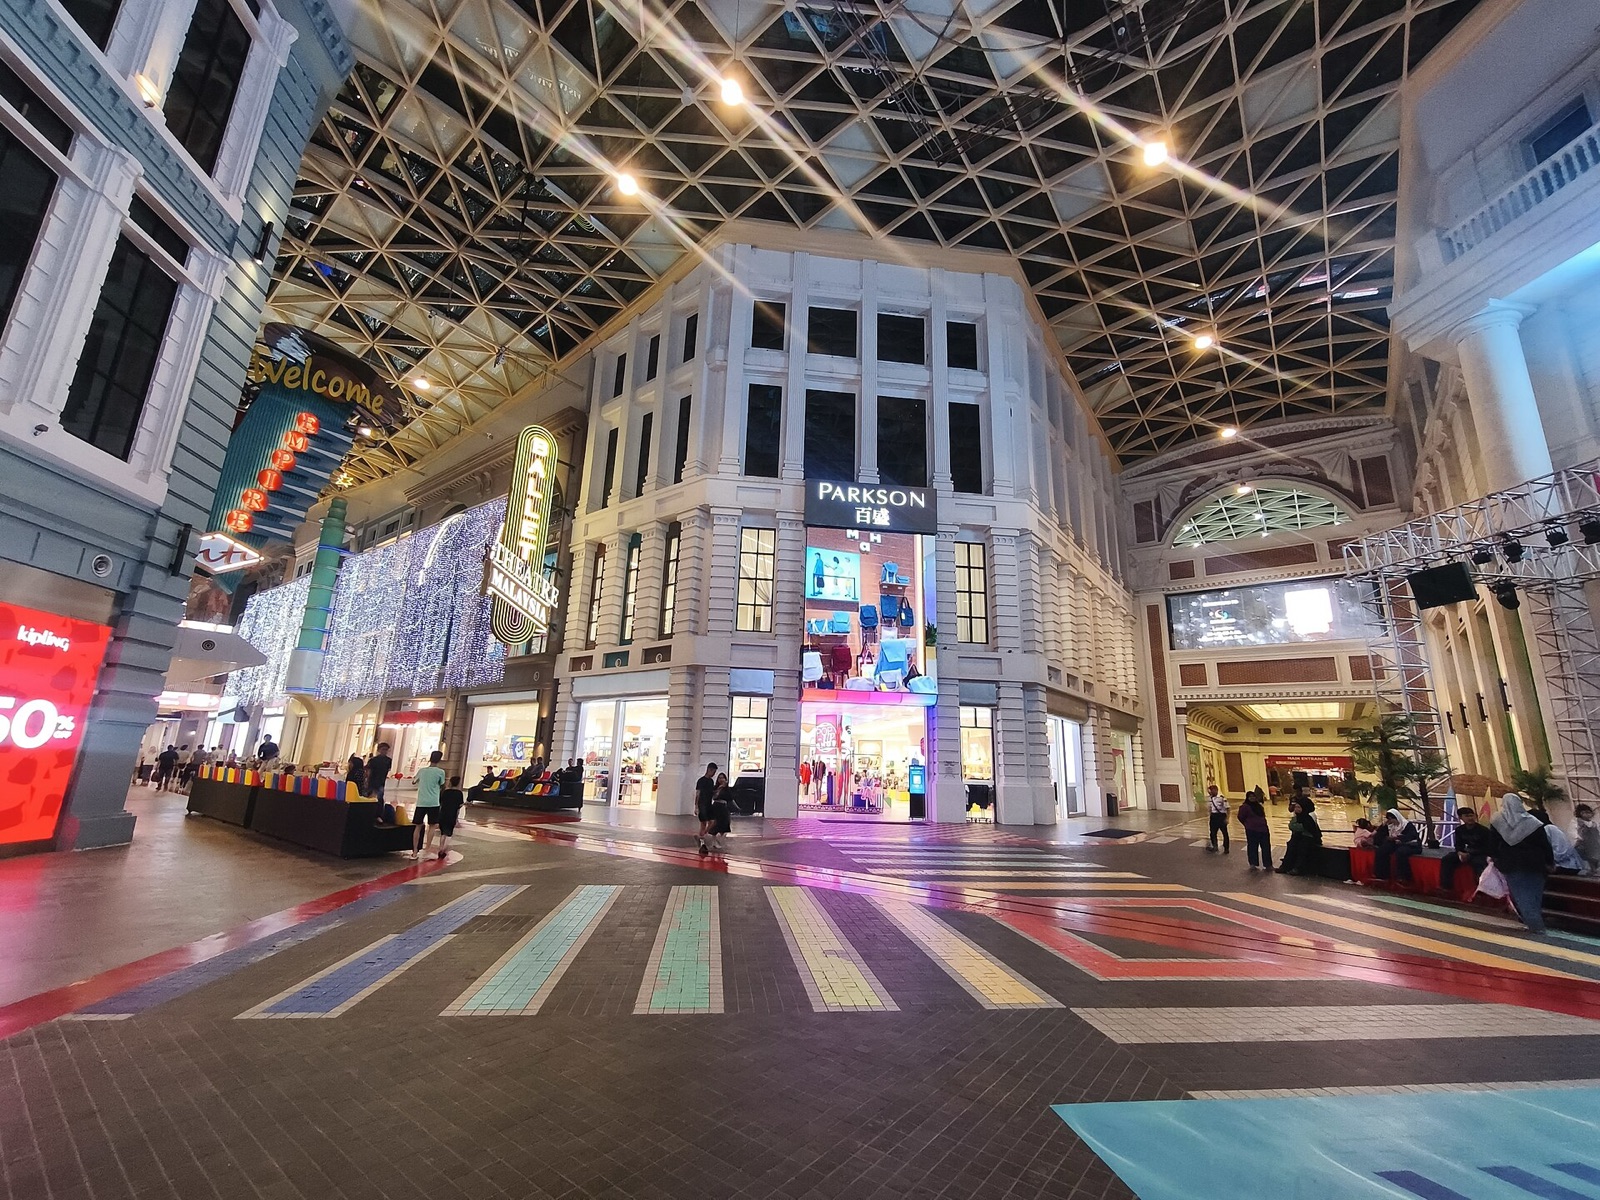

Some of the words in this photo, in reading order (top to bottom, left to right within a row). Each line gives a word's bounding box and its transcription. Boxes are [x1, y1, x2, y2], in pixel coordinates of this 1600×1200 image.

[252, 349, 384, 414] Welcome
[230, 414, 317, 532] EMPIRE
[518, 436, 549, 562] BALLET
[819, 482, 925, 508] PARKSON
[855, 507, 890, 526] 百盛
[490, 568, 547, 625] MALAYSIA
[493, 542, 560, 609] THEATRE
[17, 625, 70, 652] kipling
